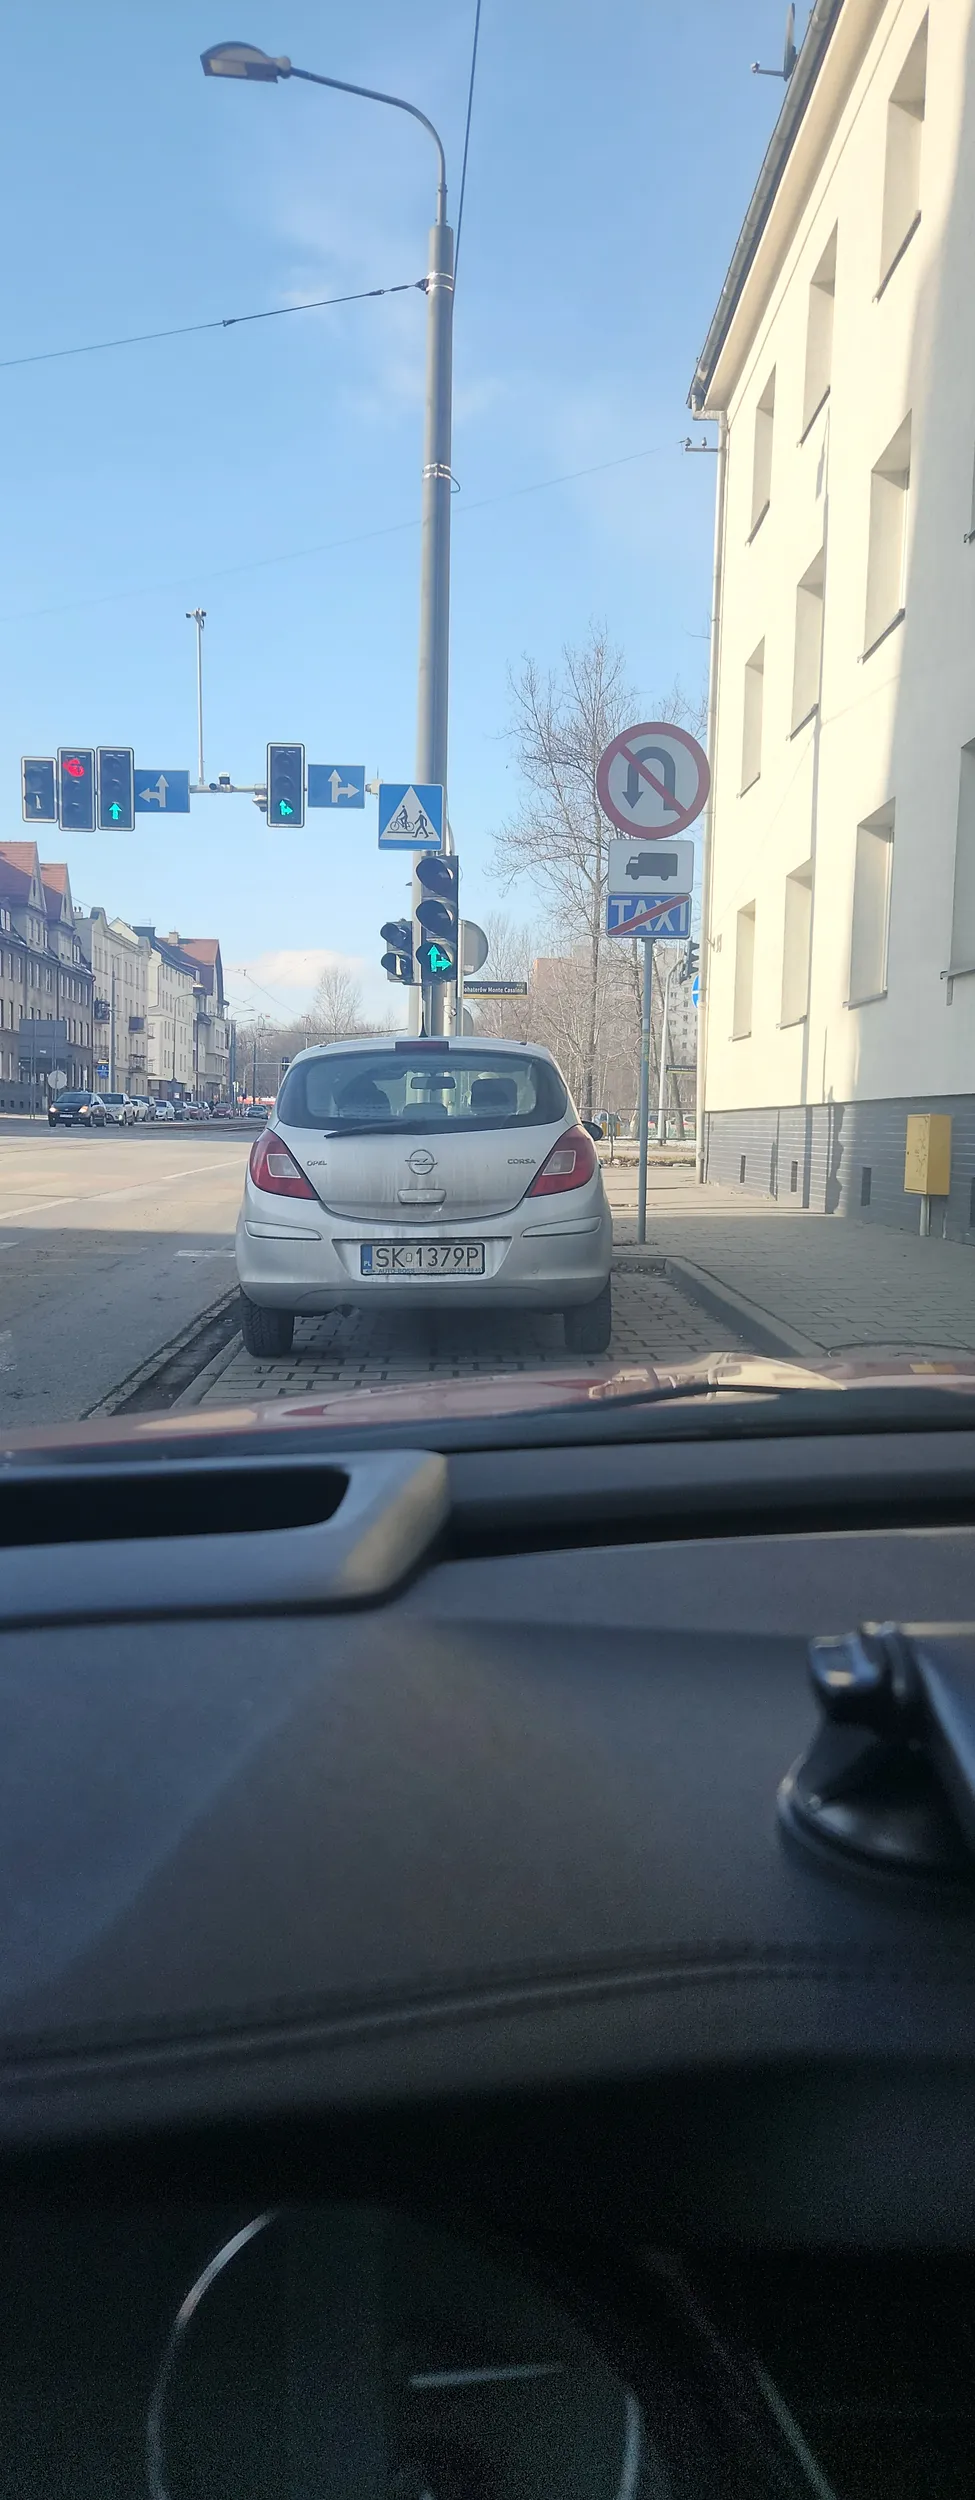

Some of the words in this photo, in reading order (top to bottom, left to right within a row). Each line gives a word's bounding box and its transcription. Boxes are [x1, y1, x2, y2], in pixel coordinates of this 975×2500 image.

[611, 899, 687, 932] TAXI
[376, 1247, 405, 1268] SK
[415, 1247, 479, 1267] 1379P
